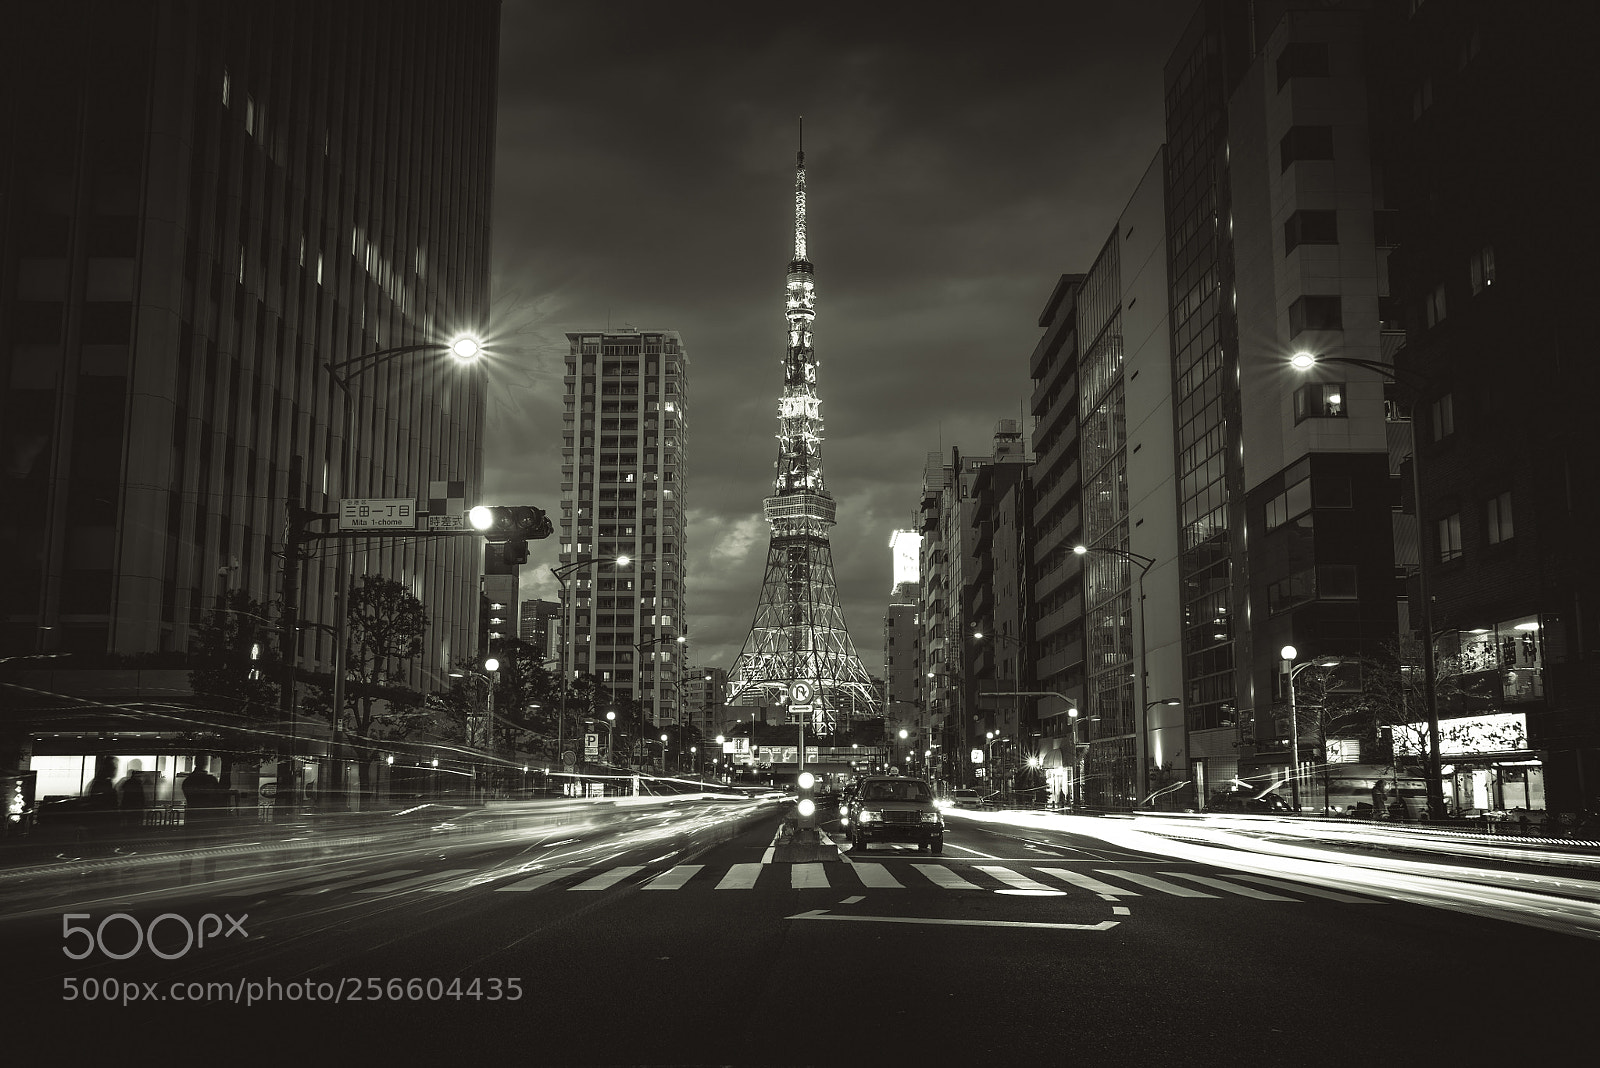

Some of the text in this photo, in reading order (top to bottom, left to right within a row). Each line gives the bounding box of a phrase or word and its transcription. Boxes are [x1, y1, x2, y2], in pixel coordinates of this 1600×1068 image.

[345, 505, 409, 517] 三田一丁目
[429, 516, 463, 527] 時差式
[588, 736, 596, 746] P
